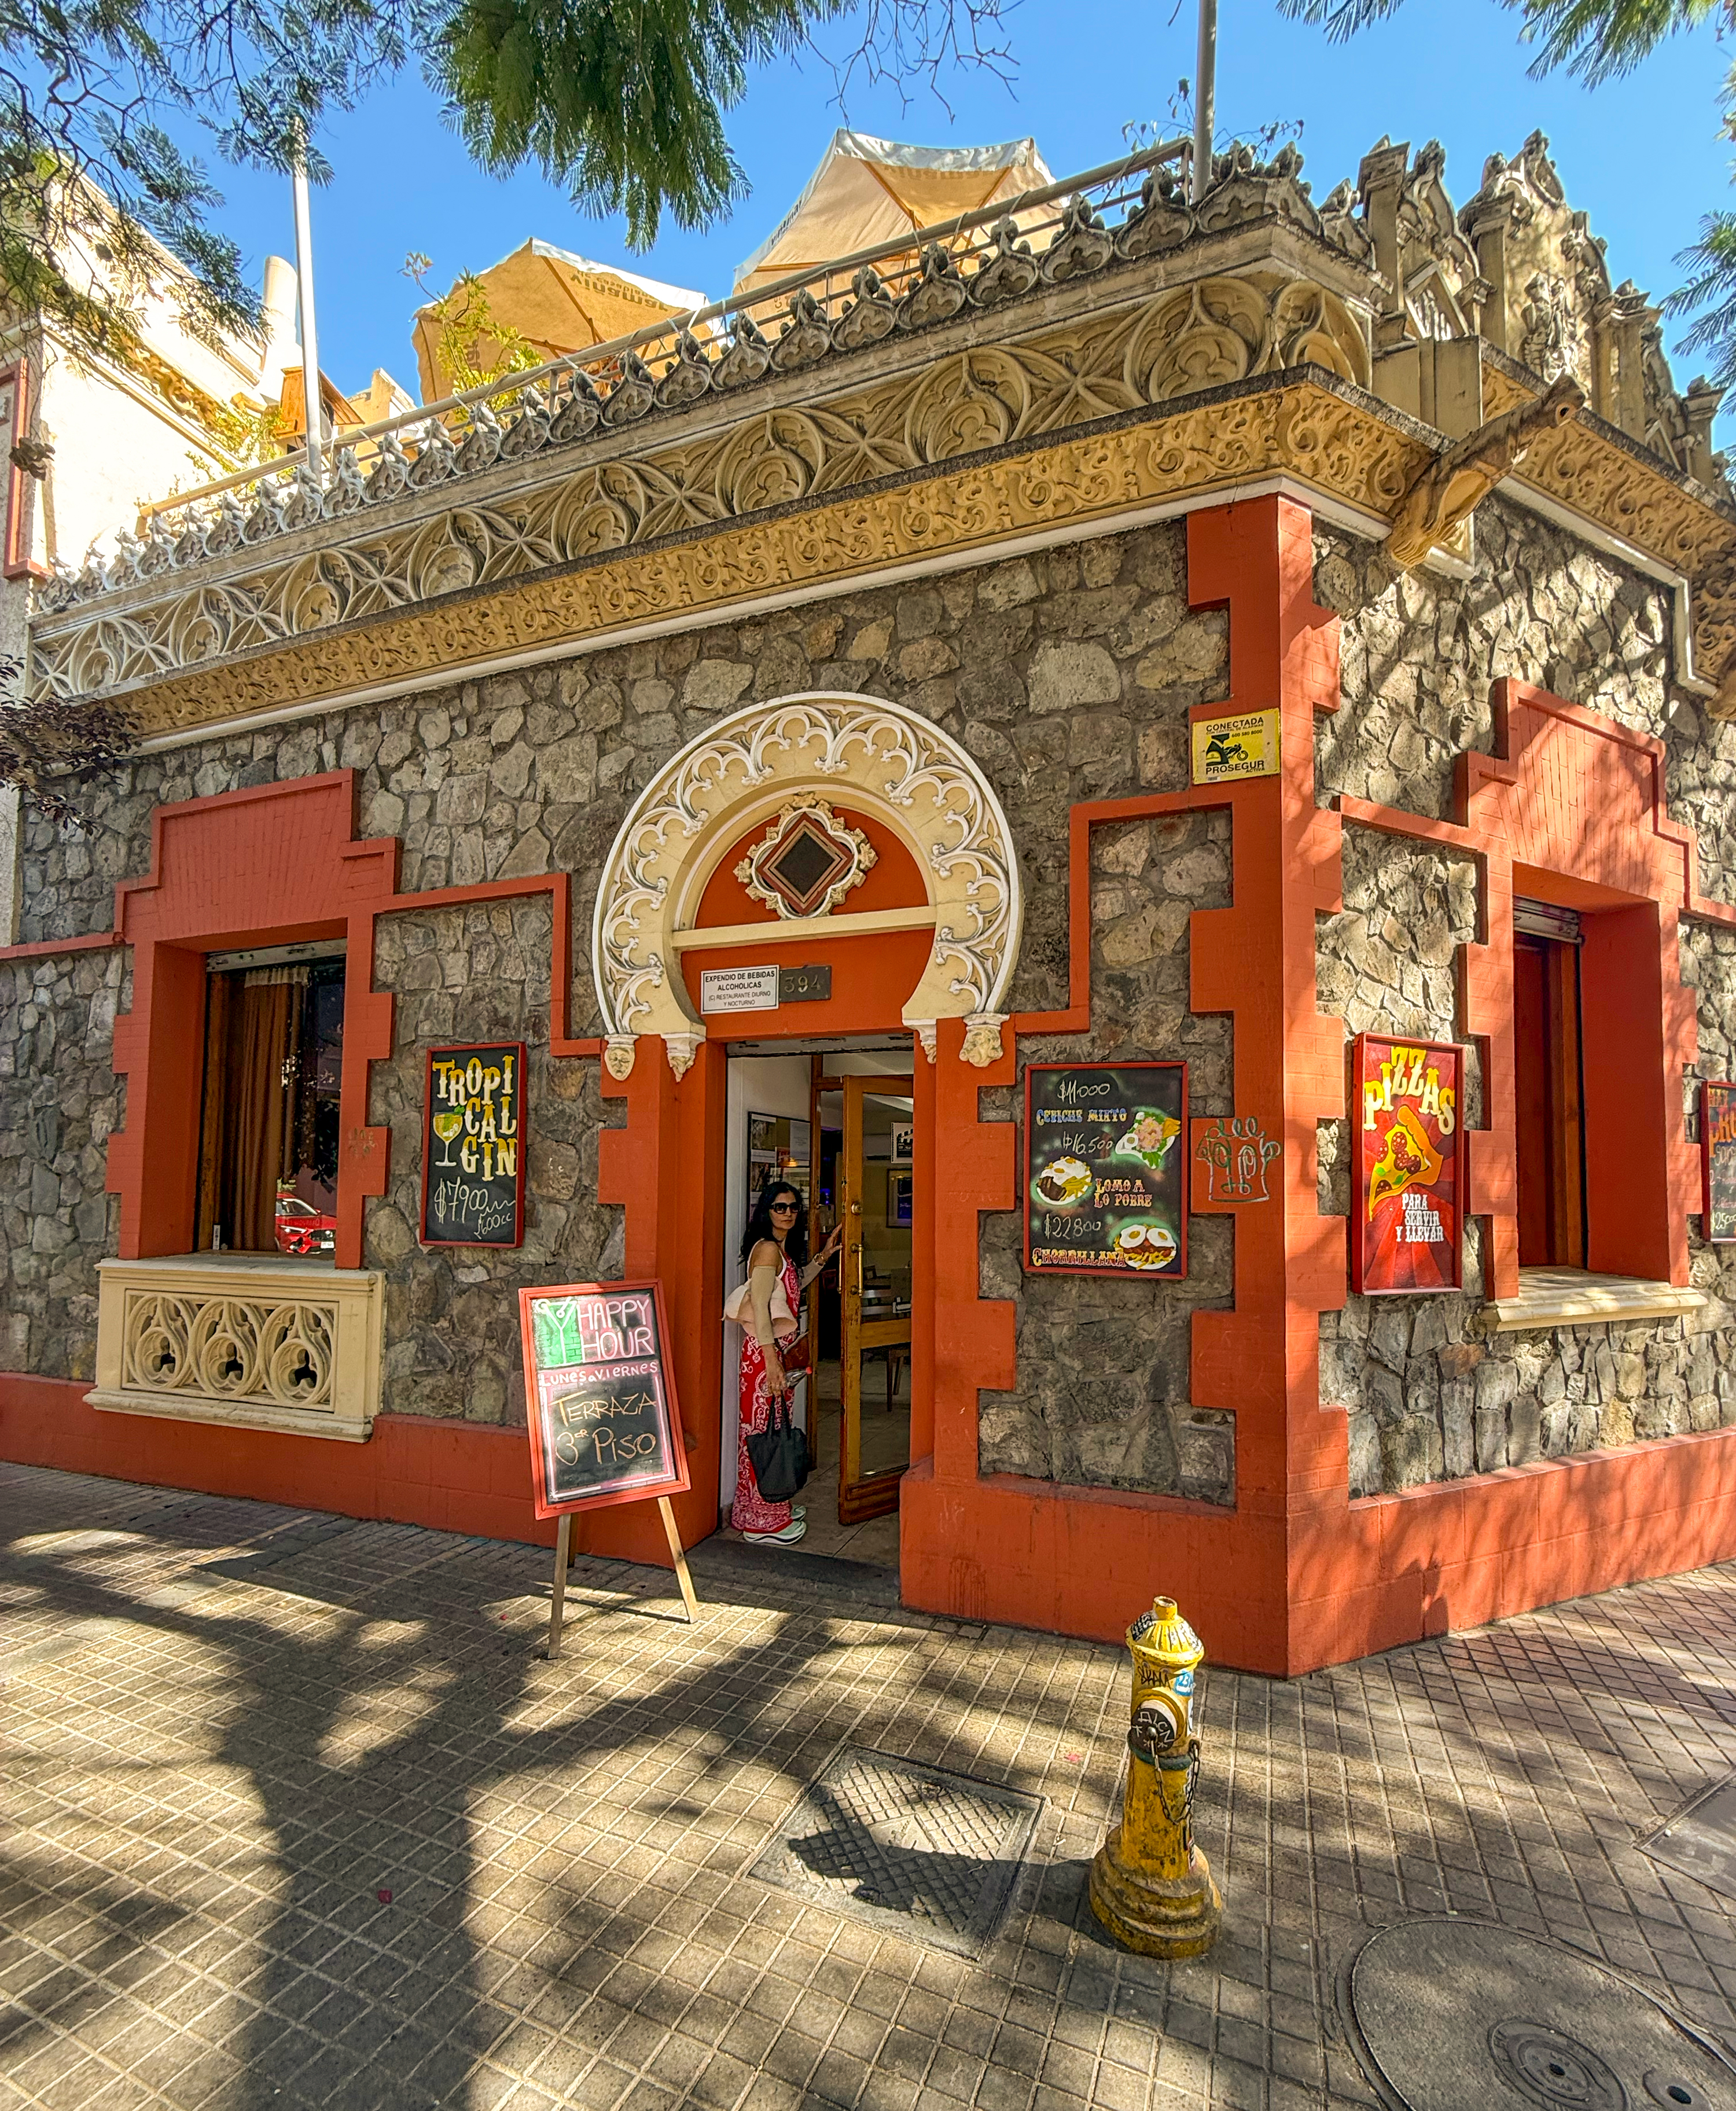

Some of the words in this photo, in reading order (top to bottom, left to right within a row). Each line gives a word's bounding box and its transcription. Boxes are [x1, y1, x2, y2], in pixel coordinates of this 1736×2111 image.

[1206, 717, 1264, 732] CONECTADA
[1206, 760, 1264, 774] PROSEGUR
[705, 974, 736, 982] EXPENDIO
[747, 971, 775, 979] BEBIDAS
[784, 974, 822, 993] 394
[717, 981, 762, 991] ALCOHOLICAS
[716, 992, 751, 1000] RESTAURANTE
[432, 1055, 515, 1107] TROPI
[1363, 1046, 1455, 1135] PIZZAS
[464, 1095, 517, 1143] CAL
[1036, 1108, 1083, 1126] CEVICHE
[1087, 1108, 1128, 1122] MIXTO
[459, 1135, 518, 1181] GIN
[1095, 1178, 1132, 1194] LOMO
[1132, 1179, 1145, 1192] A
[1094, 1192, 1110, 1208] LO
[1114, 1194, 1153, 1207] POBRE
[1401, 1193, 1428, 1210] PARA
[1404, 1210, 1440, 1227] SERVIR
[1395, 1225, 1403, 1242] Y
[1405, 1225, 1444, 1243] LLEVAR
[1032, 1247, 1127, 1268] CHORRILLANA
[576, 1298, 649, 1331] HAPPY
[580, 1327, 655, 1363] HOUR
[549, 1390, 657, 1427] TERRAZA
